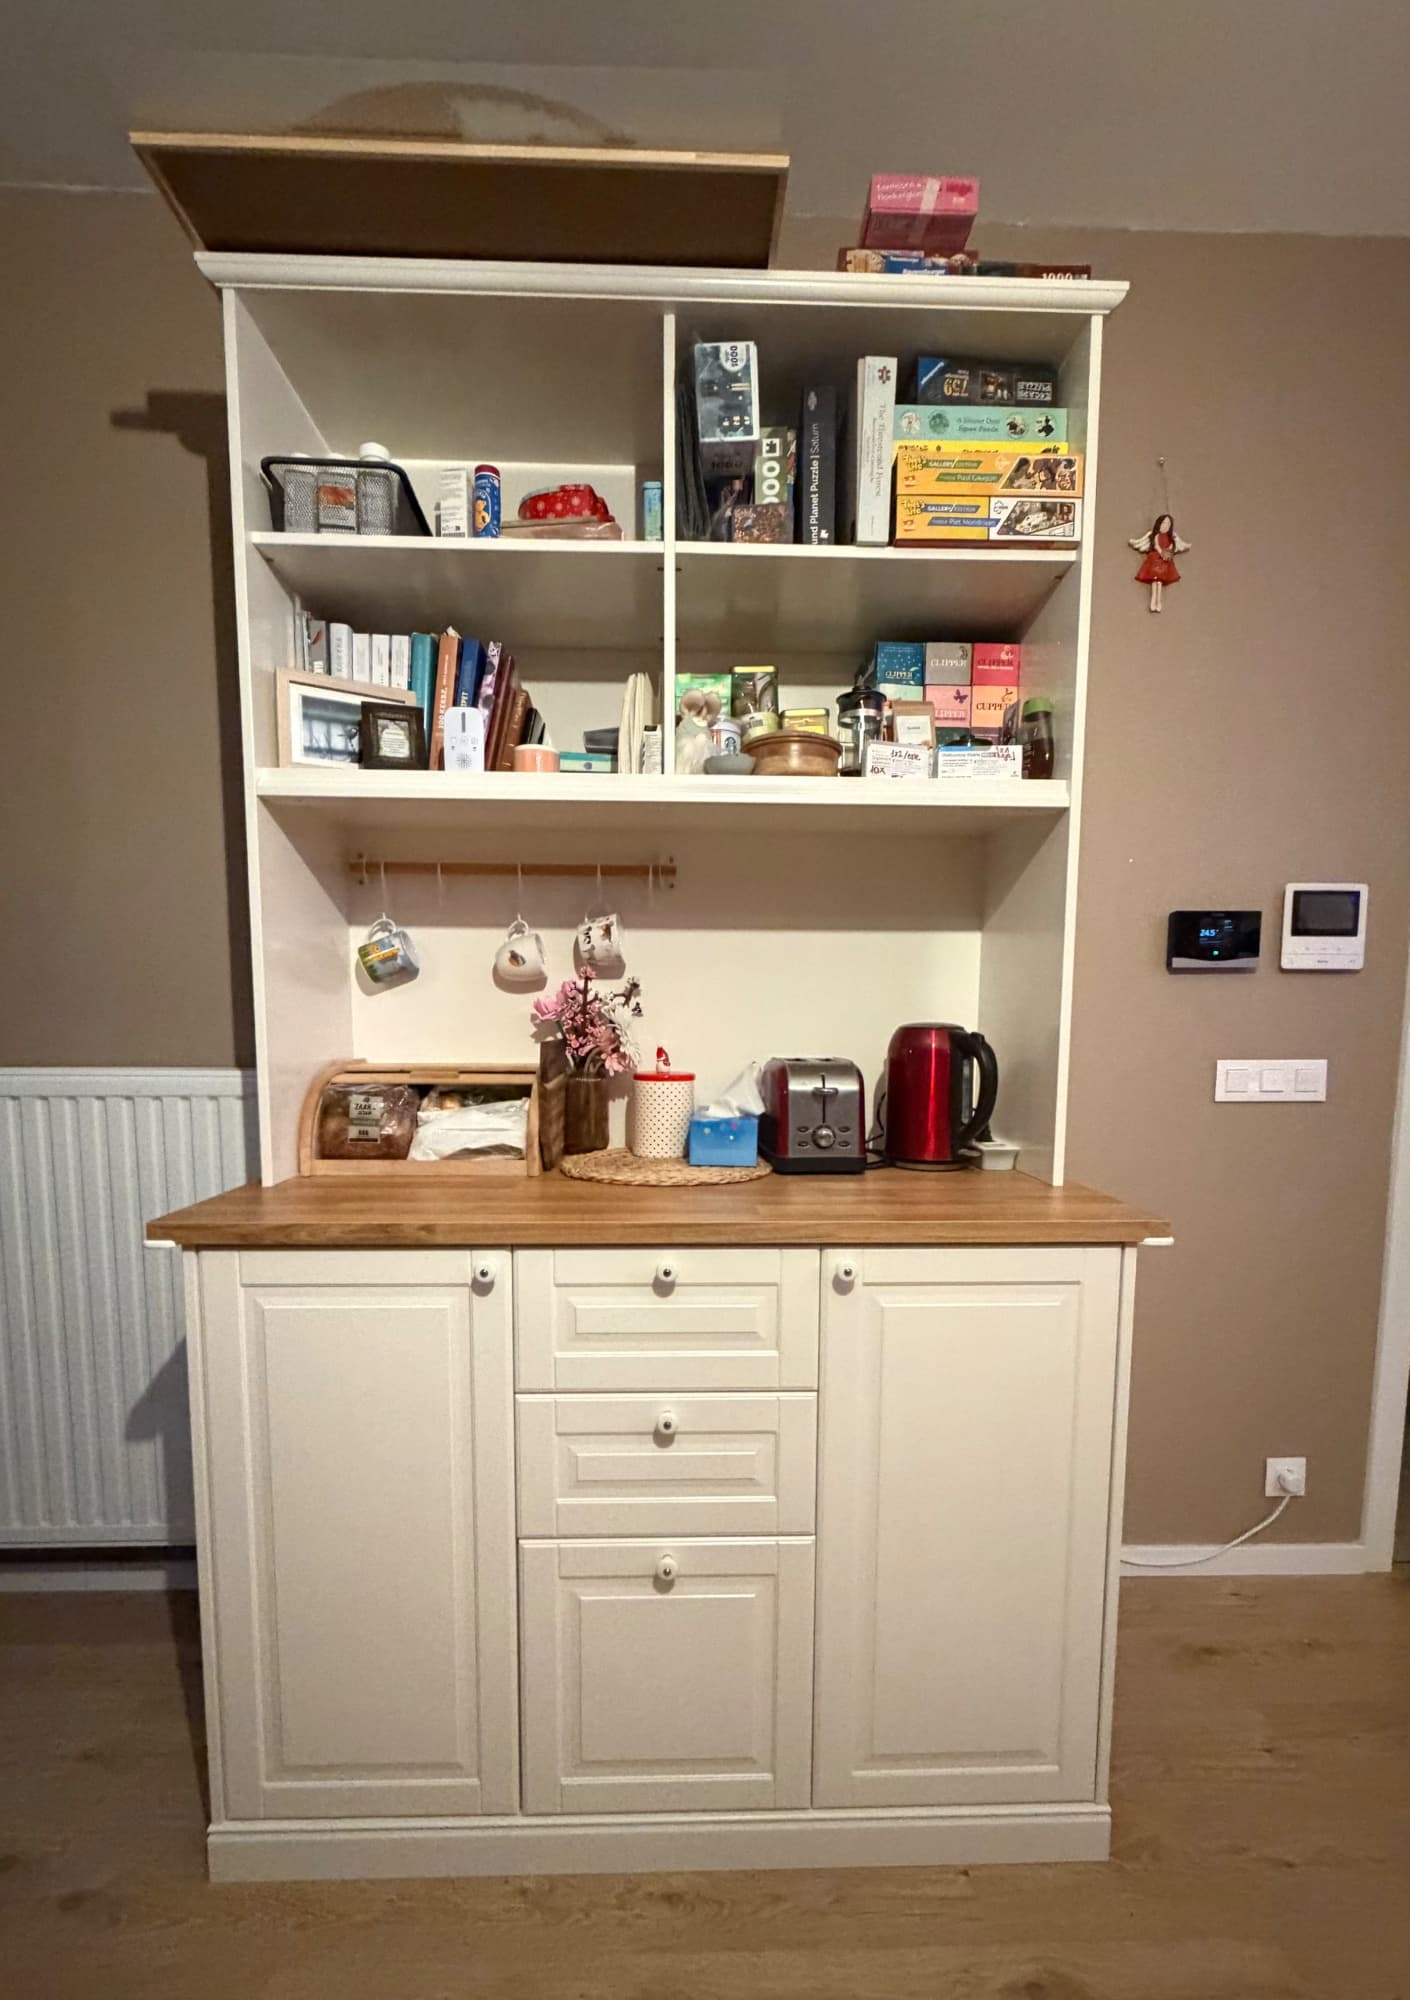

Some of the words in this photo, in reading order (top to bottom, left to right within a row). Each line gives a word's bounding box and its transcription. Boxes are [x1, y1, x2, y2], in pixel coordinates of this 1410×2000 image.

[730, 345, 740, 368] 1000
[943, 378, 969, 397] 759
[810, 423, 820, 454] Saturn
[810, 460, 820, 492] Puzzle
[810, 493, 819, 525] Planet
[930, 658, 967, 667] CLIPPER
[885, 670, 913, 679] CLIPPER
[934, 708, 967, 718] LIPPER
